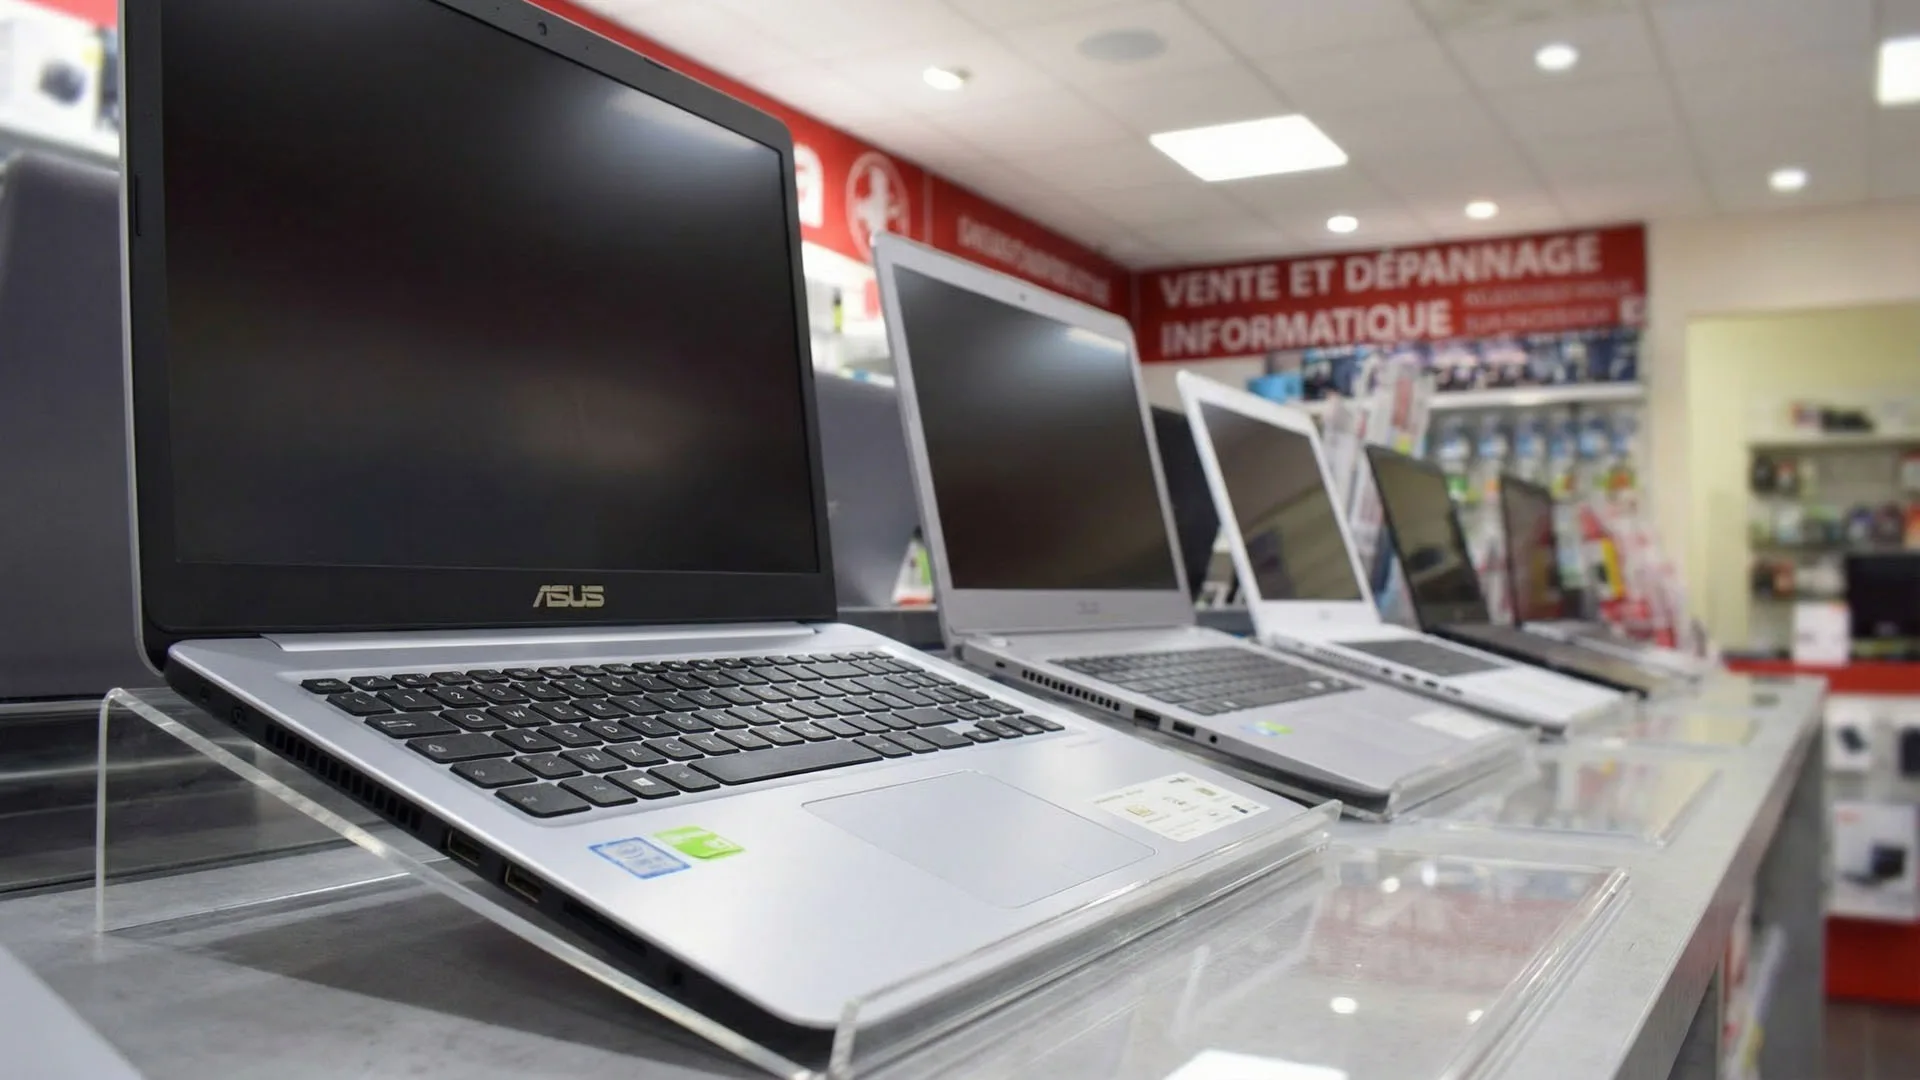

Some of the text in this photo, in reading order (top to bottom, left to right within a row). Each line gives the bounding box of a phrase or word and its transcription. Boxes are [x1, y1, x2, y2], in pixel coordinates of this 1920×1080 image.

[1160, 264, 1280, 308] VENTE
[1289, 257, 1337, 298] ET
[1344, 232, 1601, 293] DÉPANNAGE
[1160, 298, 1452, 358] INFORMATIQUE
[533, 585, 605, 608] ASUS
